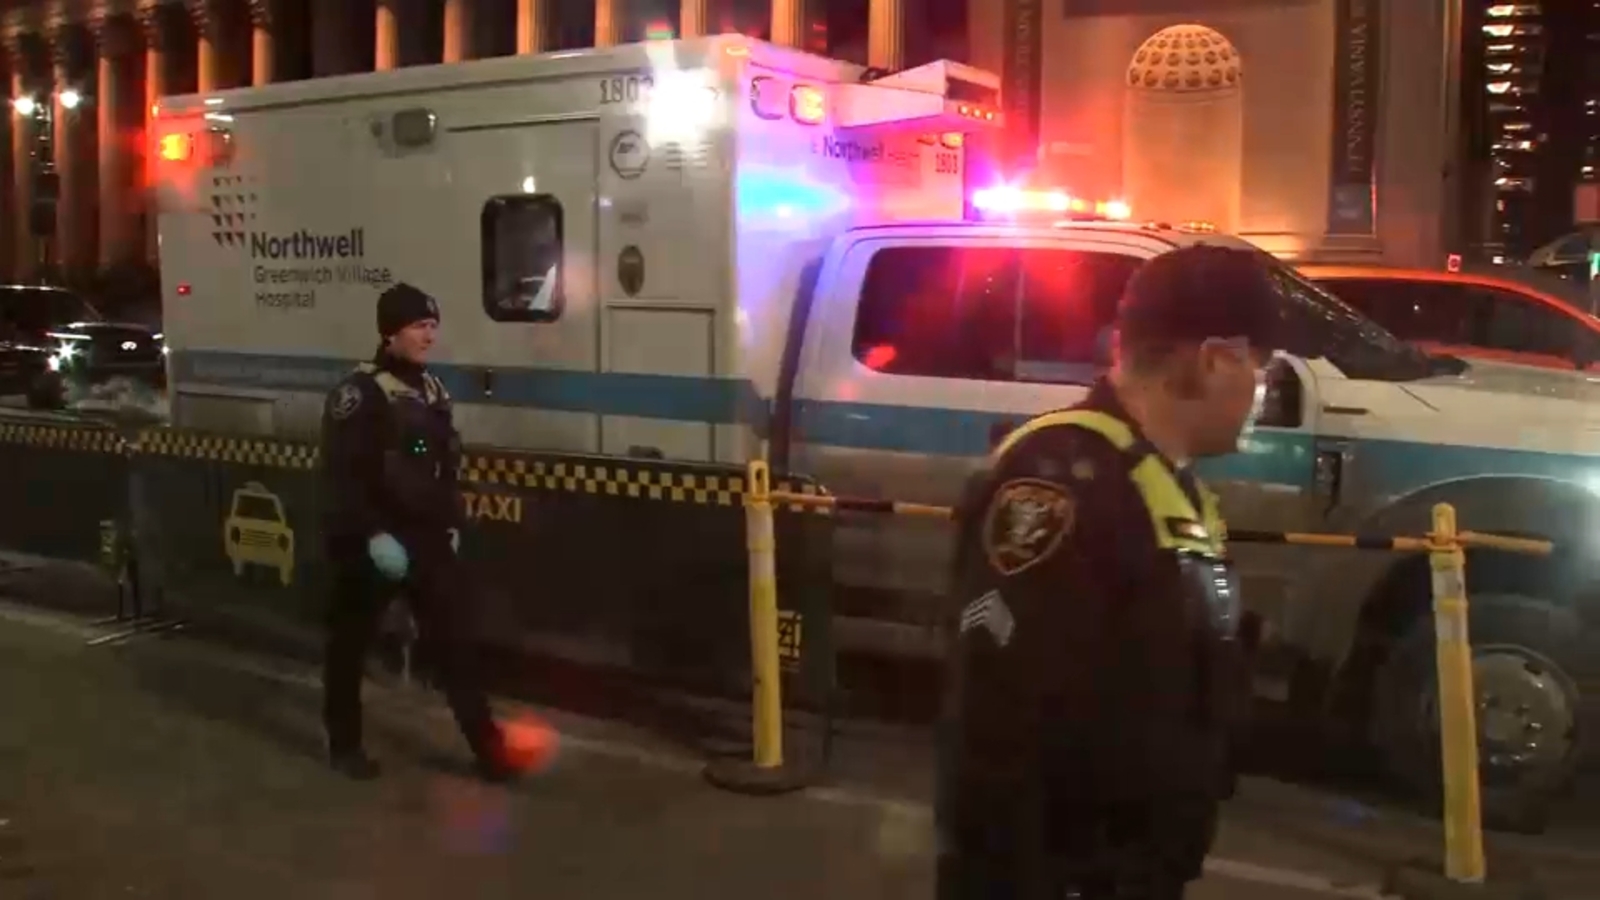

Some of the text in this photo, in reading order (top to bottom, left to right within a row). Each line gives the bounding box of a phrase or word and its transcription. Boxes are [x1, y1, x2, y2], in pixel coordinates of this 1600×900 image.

[251, 228, 364, 259] Northwell
[254, 265, 391, 288] Greenwich Village
[256, 290, 315, 309] Hospital
[461, 493, 521, 523] TAXI
